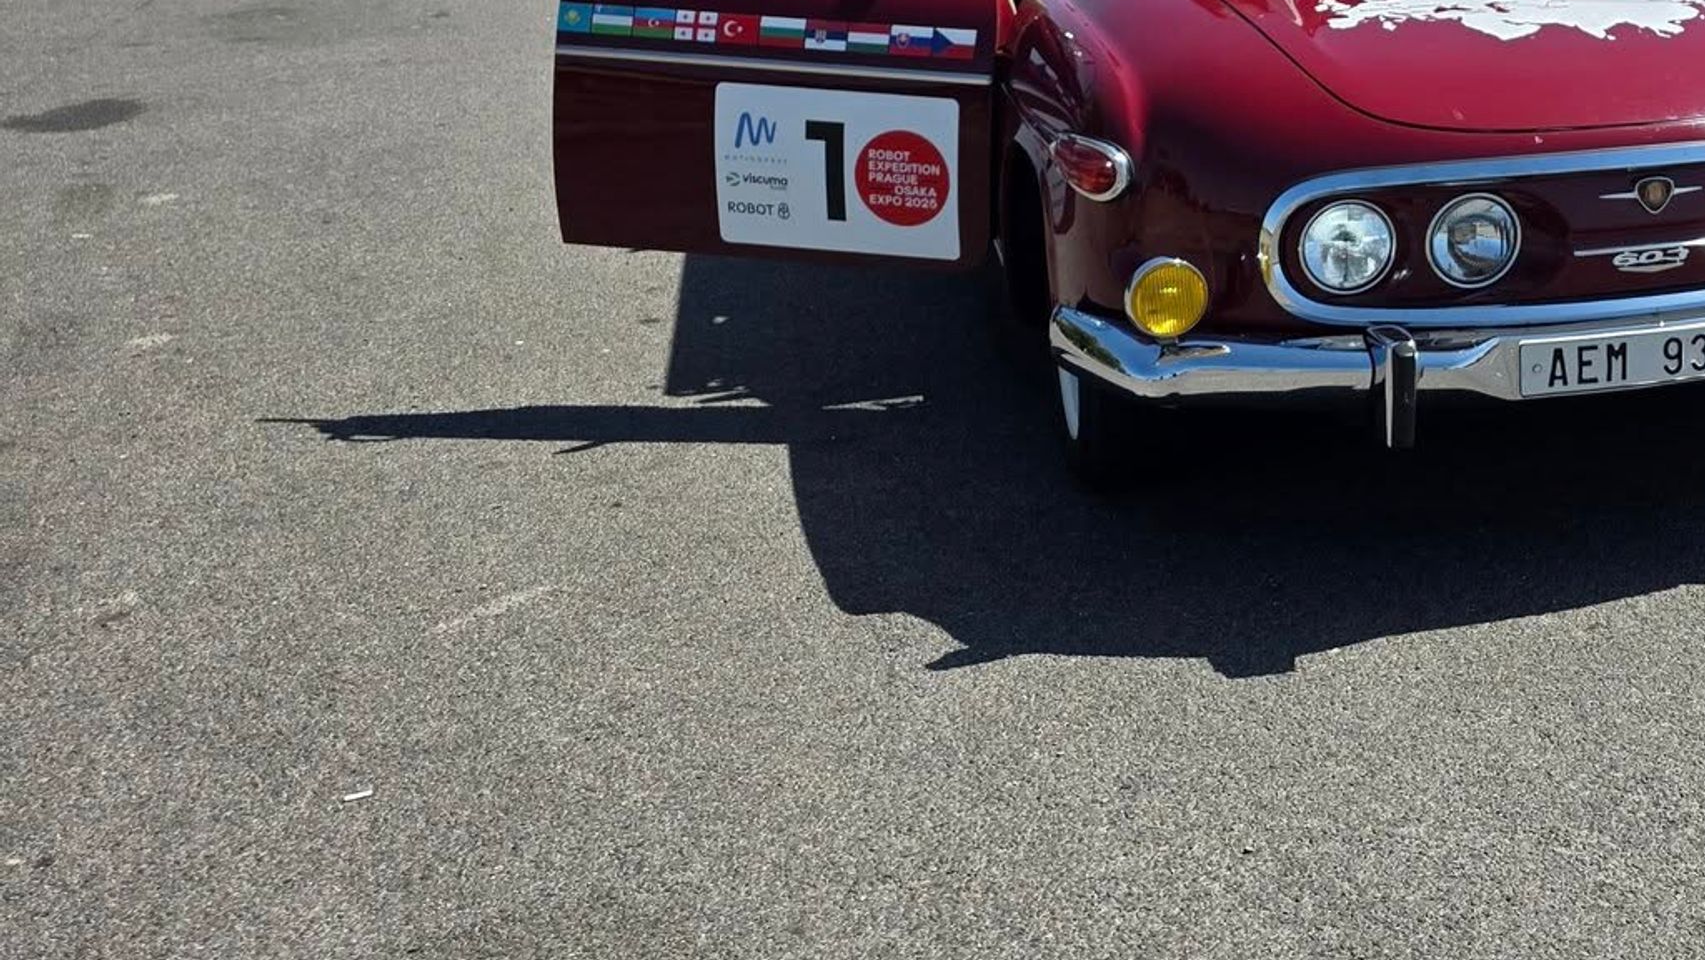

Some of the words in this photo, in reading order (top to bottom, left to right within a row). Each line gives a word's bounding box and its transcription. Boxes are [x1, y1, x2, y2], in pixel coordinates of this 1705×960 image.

[868, 148, 911, 161] ROBOT
[805, 119, 847, 222] 1
[868, 161, 941, 176] EXPEDITION
[868, 172, 918, 185] PRAGUE
[894, 185, 937, 198] OSAKA
[727, 201, 774, 216] ROBOT
[869, 194, 902, 207] EXPO
[904, 196, 938, 210] 2025
[1548, 341, 1627, 388] AEM
